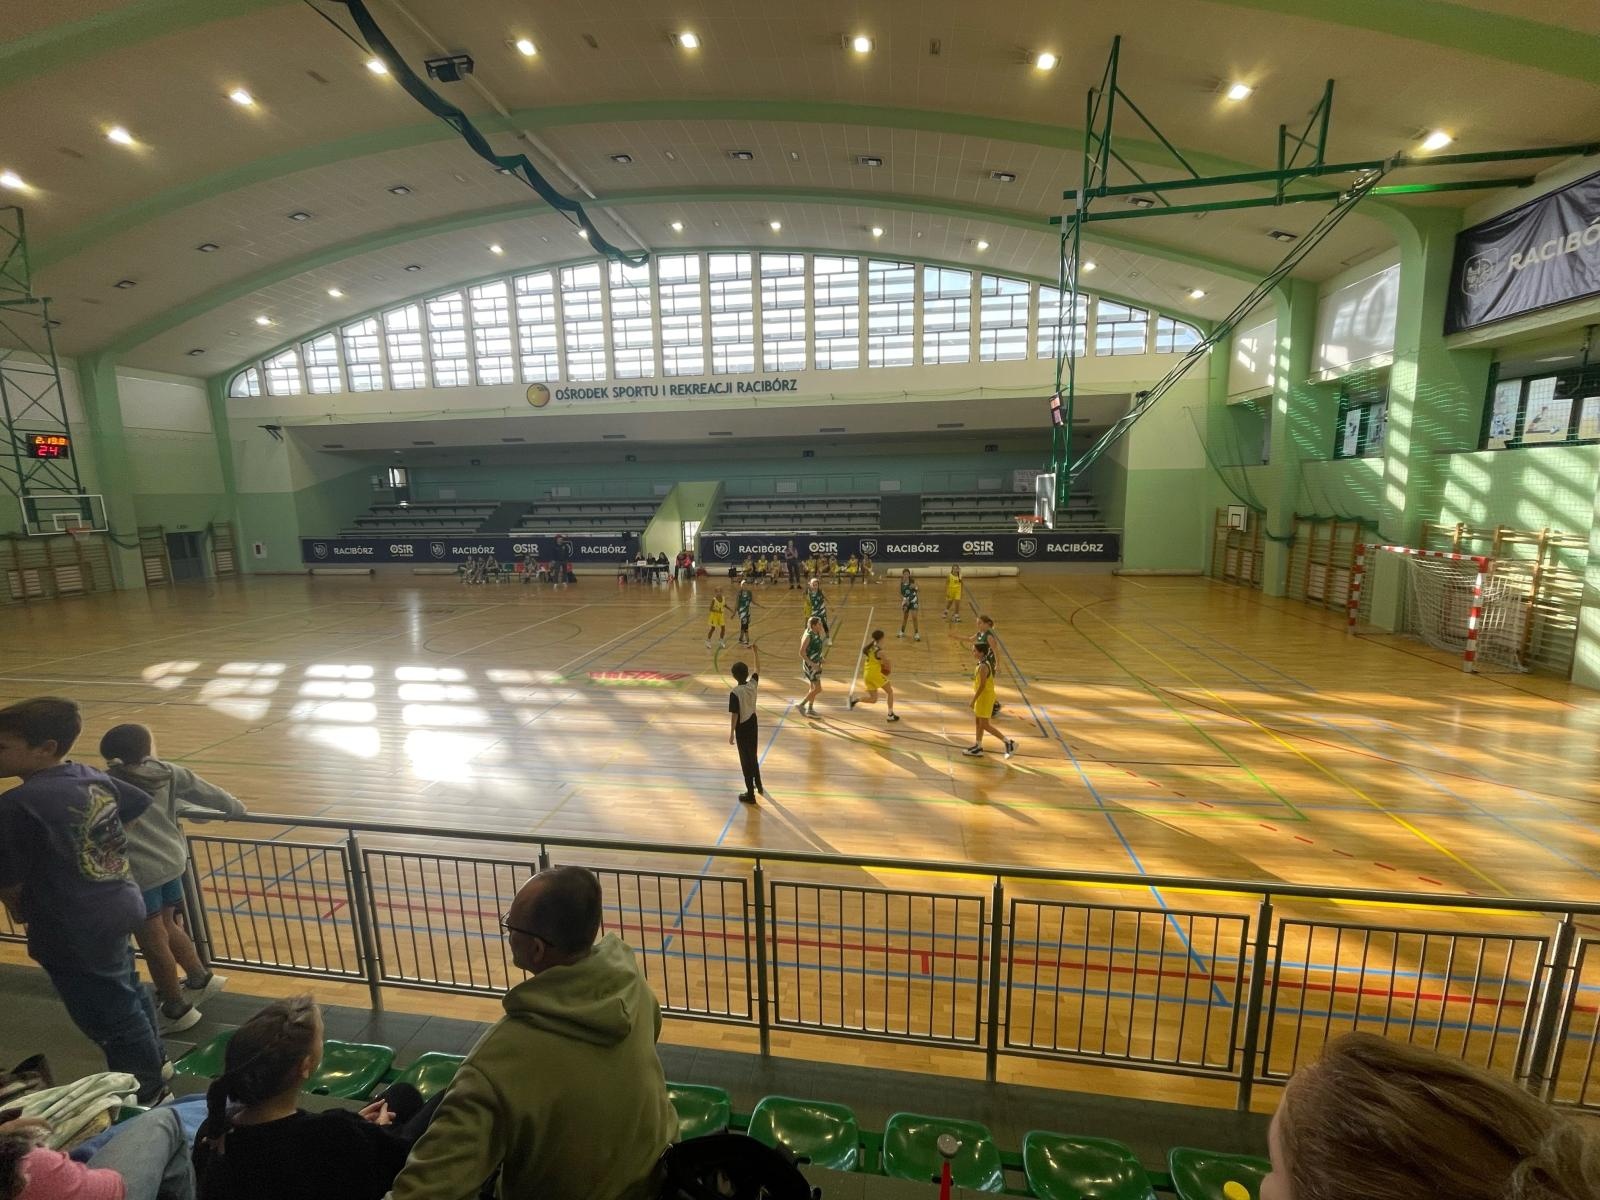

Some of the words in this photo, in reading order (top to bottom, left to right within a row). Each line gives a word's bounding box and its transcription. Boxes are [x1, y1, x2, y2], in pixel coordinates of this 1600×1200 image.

[555, 386, 609, 400] OŚRODEK
[612, 385, 658, 398] SPORTU
[669, 382, 732, 396] REKREACJI
[737, 377, 798, 393] RACIBÓRZ
[38, 445, 58, 456] 24
[333, 545, 374, 555] RACIBÓRZ
[452, 544, 495, 554] RACIBÓRZ
[580, 543, 627, 554] RACIBÓRZ
[738, 543, 788, 553] RACIBÓRZ
[886, 542, 940, 553] RACIBÓRZ
[1046, 541, 1104, 552] RACIBÓRZ
